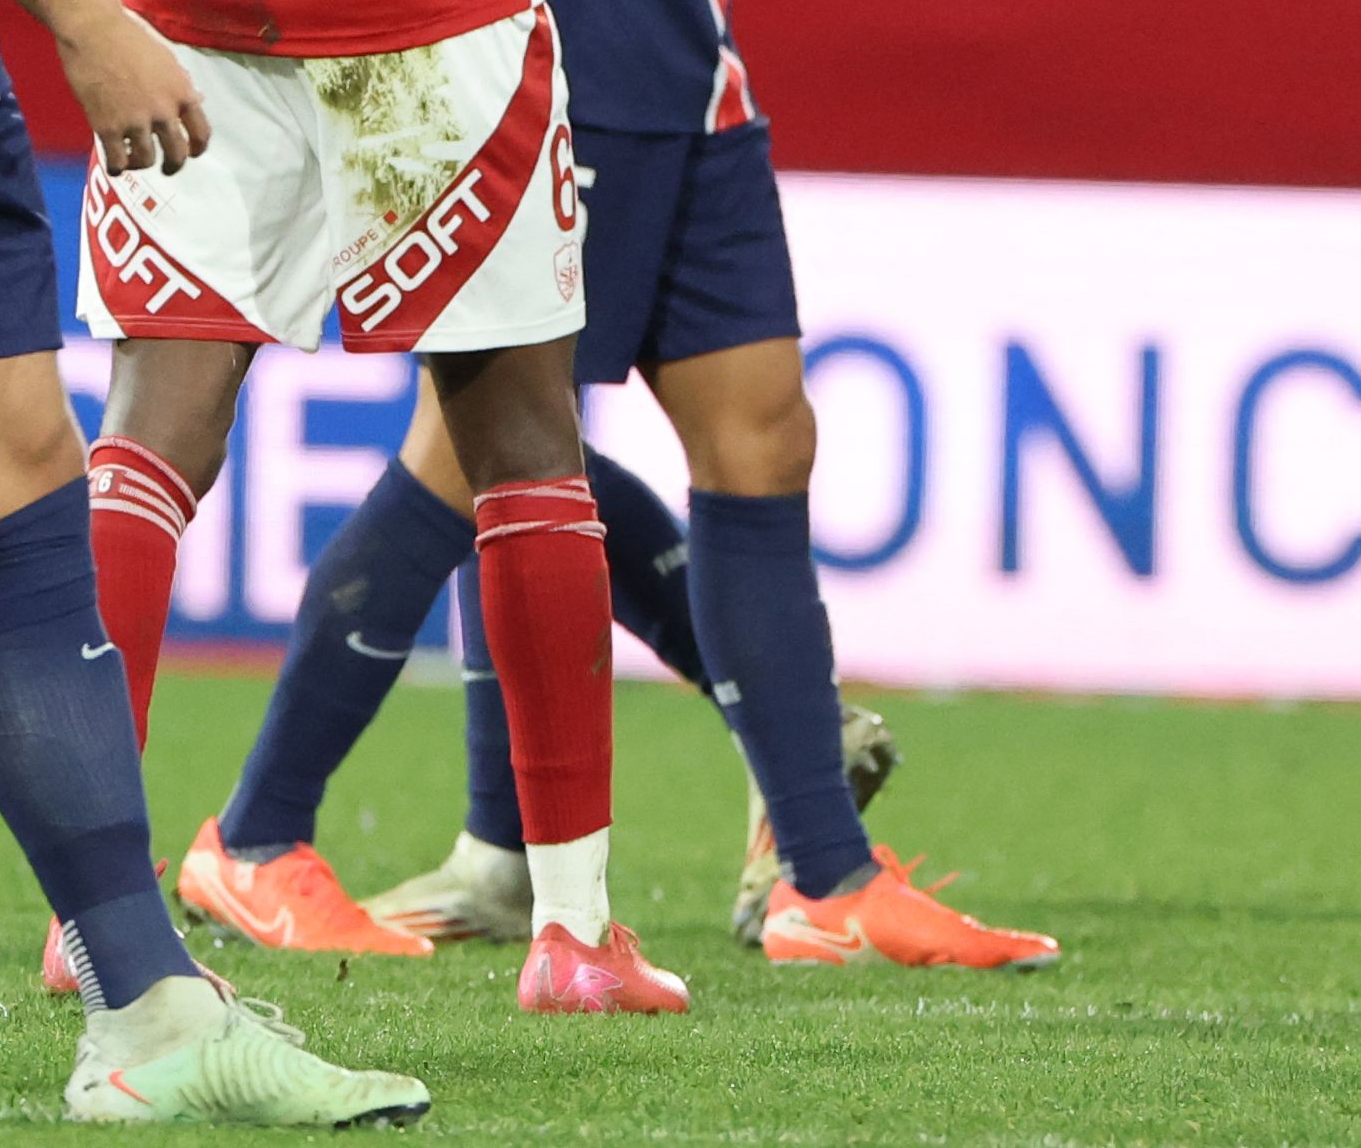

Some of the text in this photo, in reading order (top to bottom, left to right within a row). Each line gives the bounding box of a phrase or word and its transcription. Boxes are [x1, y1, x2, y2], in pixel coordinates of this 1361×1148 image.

[87, 163, 202, 314] SOFT
[550, 124, 576, 232] 6
[332, 228, 379, 273] ROUPE
[341, 167, 491, 333] SOFT
